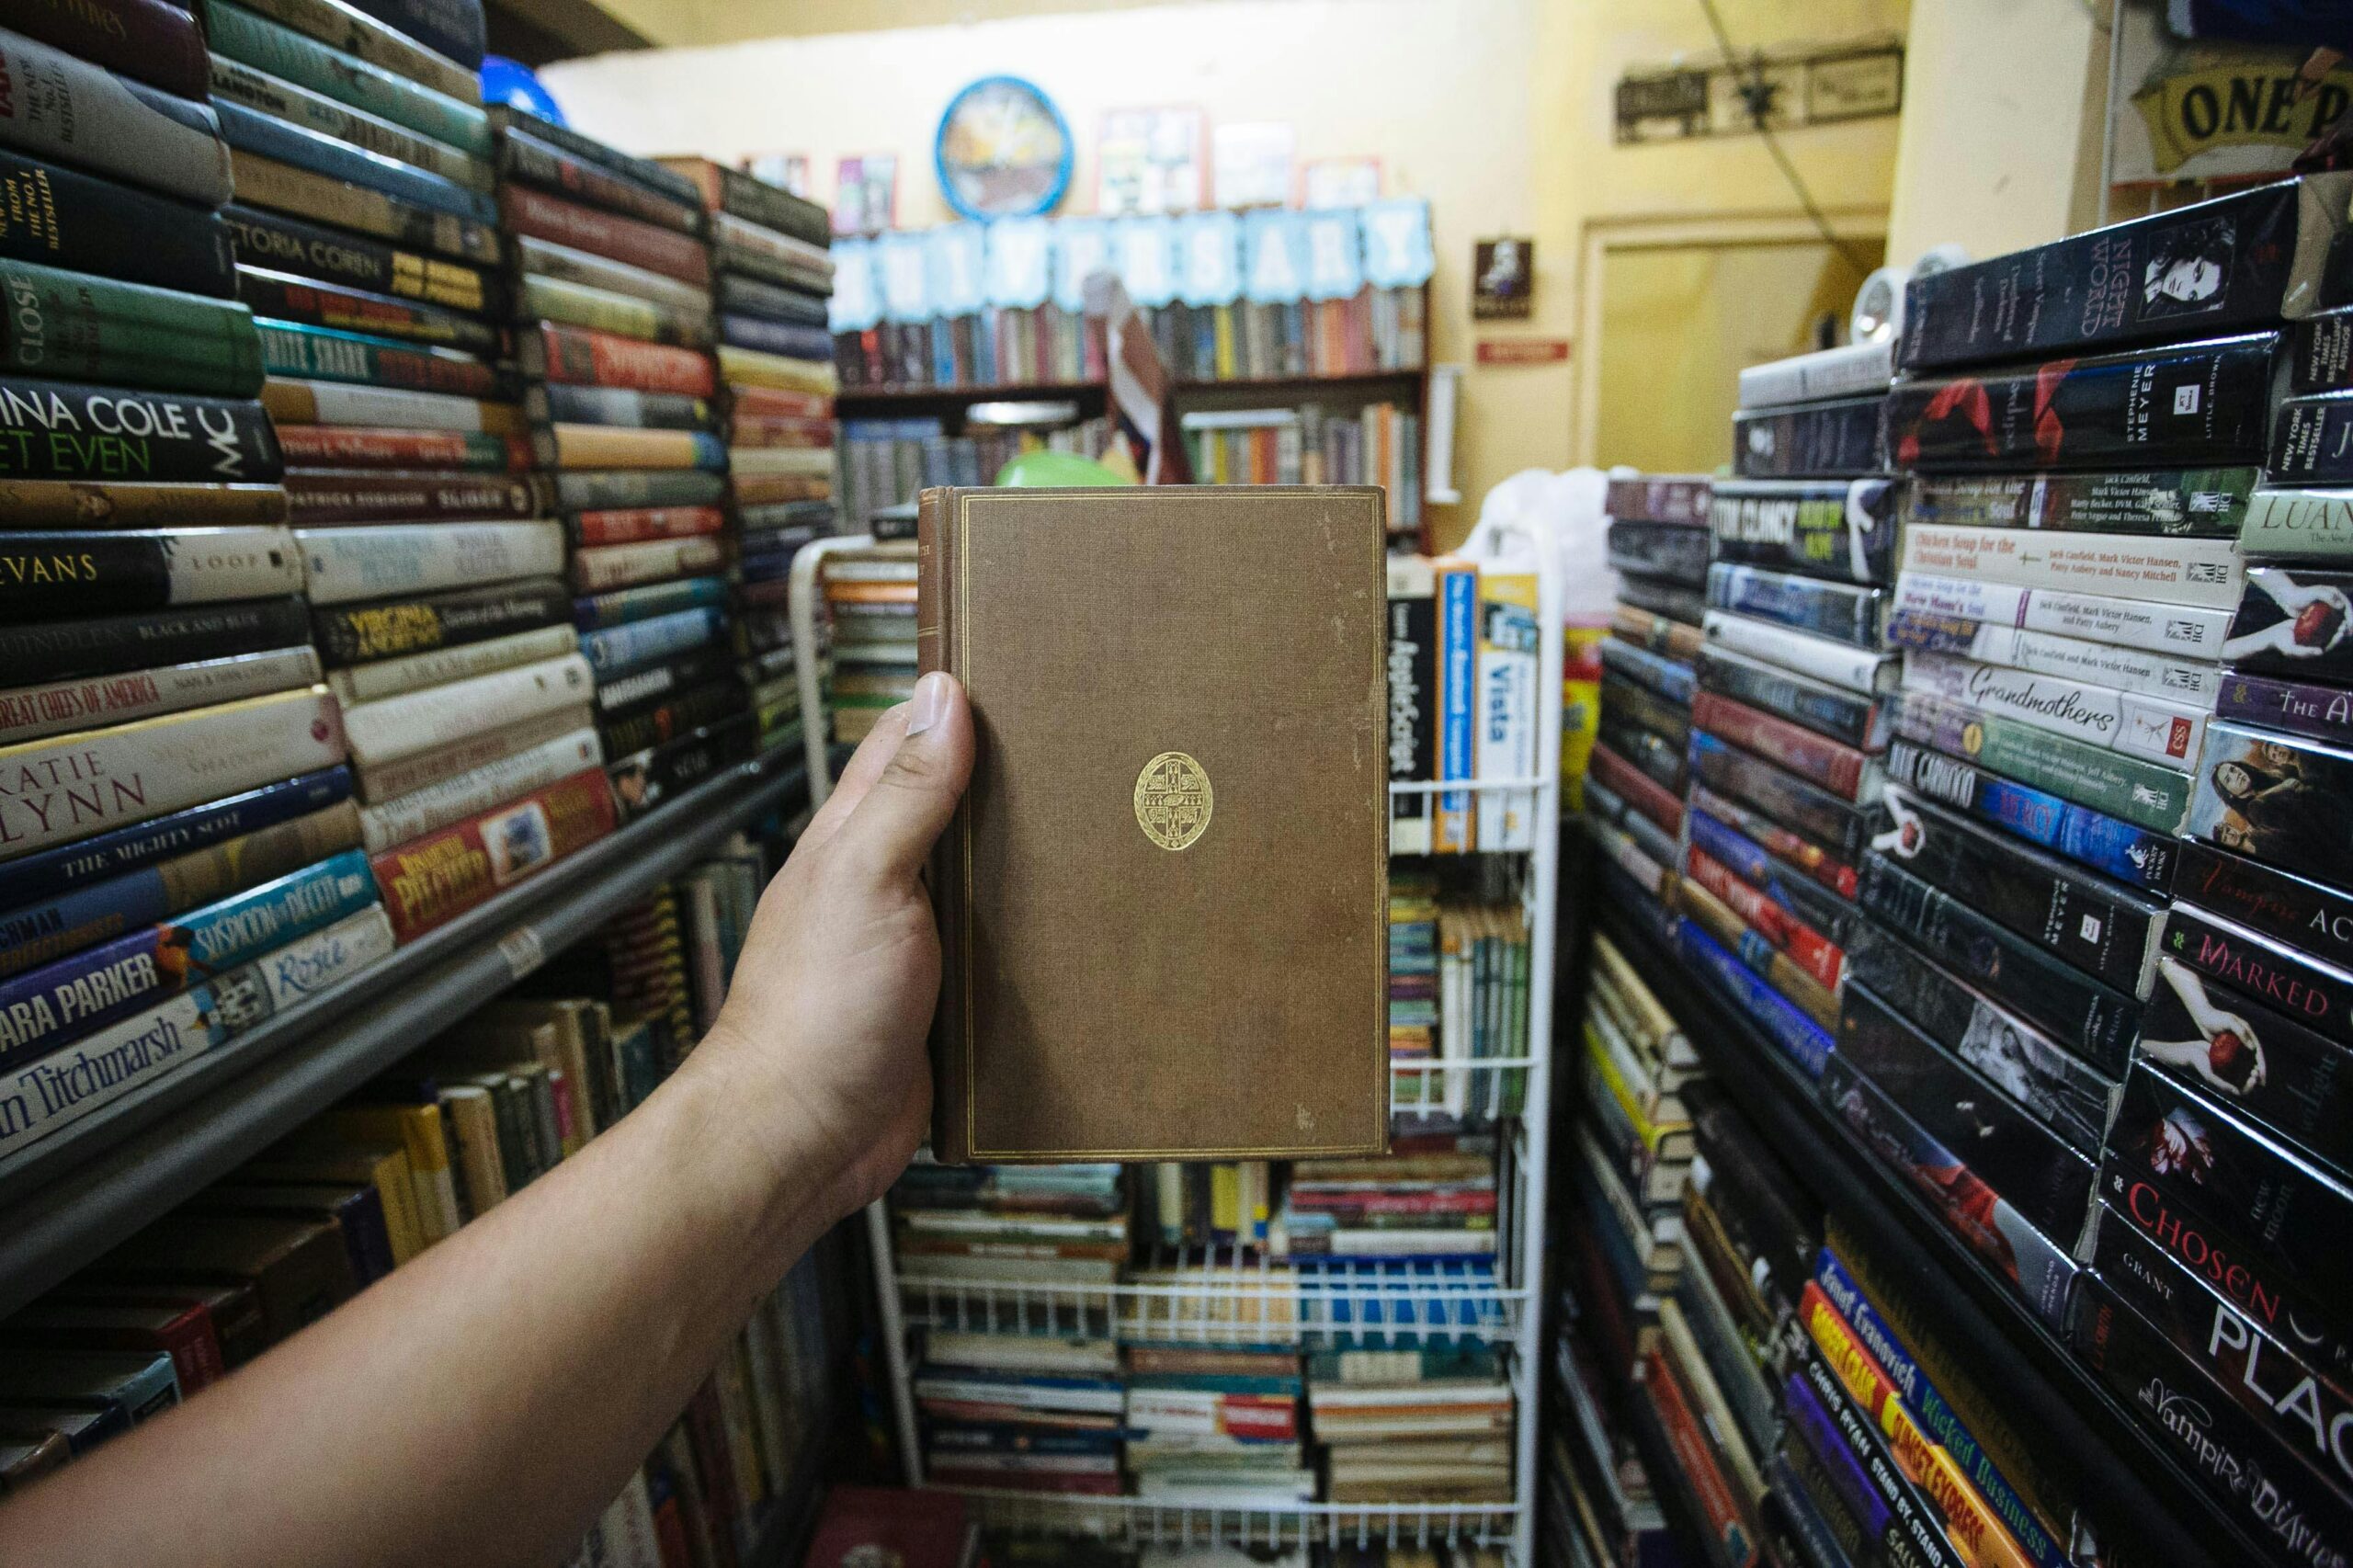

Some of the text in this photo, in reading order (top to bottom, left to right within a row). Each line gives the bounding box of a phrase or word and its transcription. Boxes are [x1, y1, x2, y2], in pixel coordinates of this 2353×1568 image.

[2181, 75, 2296, 140] ONE
[6, 177, 25, 224] FROM
[28, 208, 43, 239] THE
[34, 167, 62, 252] BESTSELLER
[2080, 235, 2110, 339] WORLD
[2101, 238, 2133, 328] NIGHT
[8, 273, 45, 367] CLOSE
[2309, 322, 2324, 383] NEW YORK
[2321, 334, 2332, 366] TIMES
[2326, 315, 2343, 384] BESTSELLING
[2208, 354, 2222, 397] BROWN
[85, 395, 193, 441] COLE
[2000, 379, 2029, 451] eclipse
[2126, 363, 2144, 443] STEPHENIE
[2138, 363, 2157, 443] MEYER
[48, 431, 152, 474] EVEN
[2280, 407, 2303, 472] NEW YORK
[2296, 421, 2313, 455] TIMES
[2303, 405, 2327, 471] BESTSELLER
[2091, 486, 2131, 497] Mark Victor
[2105, 473, 2120, 486] Jack
[2123, 511, 2151, 522] Theresa
[1953, 535, 1977, 553] Soup
[1979, 536, 1995, 552] for
[1997, 536, 2018, 554] the
[1955, 553, 1979, 570] Soul
[2050, 550, 2064, 560] Jack
[2098, 552, 2119, 563] Mark
[2120, 554, 2146, 566] Victor
[2146, 556, 2182, 569] Hansen,
[2098, 566, 2114, 578] and
[2115, 568, 2142, 582] Nancy
[2143, 570, 2177, 585] Mitchell
[2215, 564, 2230, 585] HCI
[2039, 600, 2053, 610] Jack
[2082, 606, 2100, 617] Mark
[2101, 607, 2122, 620] Victor
[2123, 611, 2153, 625] Hansen,
[2075, 616, 2094, 629] Patty
[2095, 619, 2120, 634] Aubery
[2191, 623, 2205, 643] HCI
[2081, 655, 2097, 668] Mark
[2099, 659, 2122, 673] Victor
[2122, 663, 2151, 678] Hansen
[2189, 672, 2202, 692] HCI
[39, 687, 84, 722] CHEFS
[83, 682, 103, 715] OF
[104, 676, 161, 712] AMERICA
[1488, 664, 1511, 745] Vista
[1969, 665, 2117, 733] Grandmothers
[2172, 724, 2187, 751] CSS
[62, 855, 109, 880] THE
[116, 827, 192, 866] MIGHTY
[2144, 843, 2160, 881] POCKET
[2153, 849, 2168, 881] BOOKS
[2050, 881, 2069, 947] MEYER
[54, 951, 160, 1026] PARKER
[2197, 933, 2330, 1017] MARKED
[18, 1017, 184, 1119] Titchmarsh
[2250, 1178, 2273, 1221] new
[2262, 1184, 2295, 1243] moon
[2122, 1251, 2175, 1302] GRANT
[2128, 1181, 2281, 1324] CHOSEN
[1819, 1262, 1919, 1406] Janet Evanovich
[1809, 1359, 1945, 1568] CHRIS RYAN STAND STAND
[1921, 1384, 2048, 1562] Wicked Business
